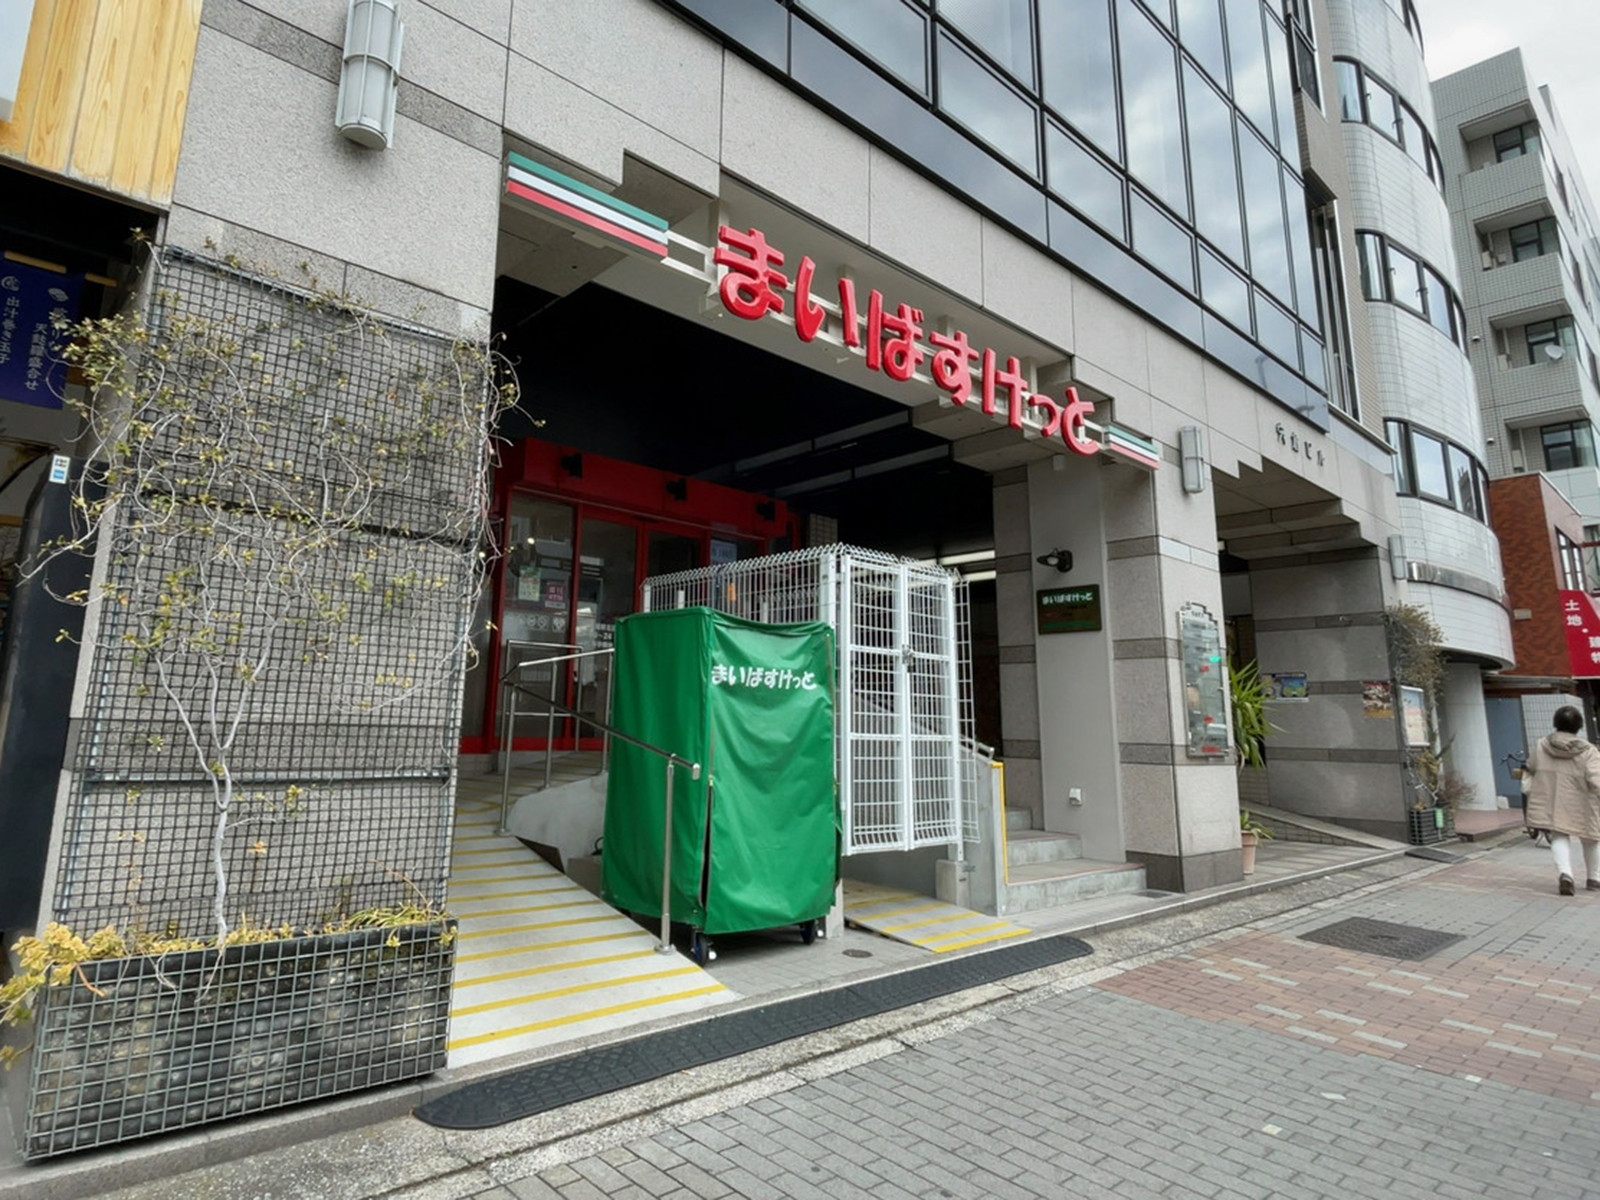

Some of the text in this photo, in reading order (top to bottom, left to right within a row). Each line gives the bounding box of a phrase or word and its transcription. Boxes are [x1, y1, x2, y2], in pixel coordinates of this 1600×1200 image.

[704, 225, 1099, 455] まいばすけっと
[711, 663, 817, 690] まいばすけっと
